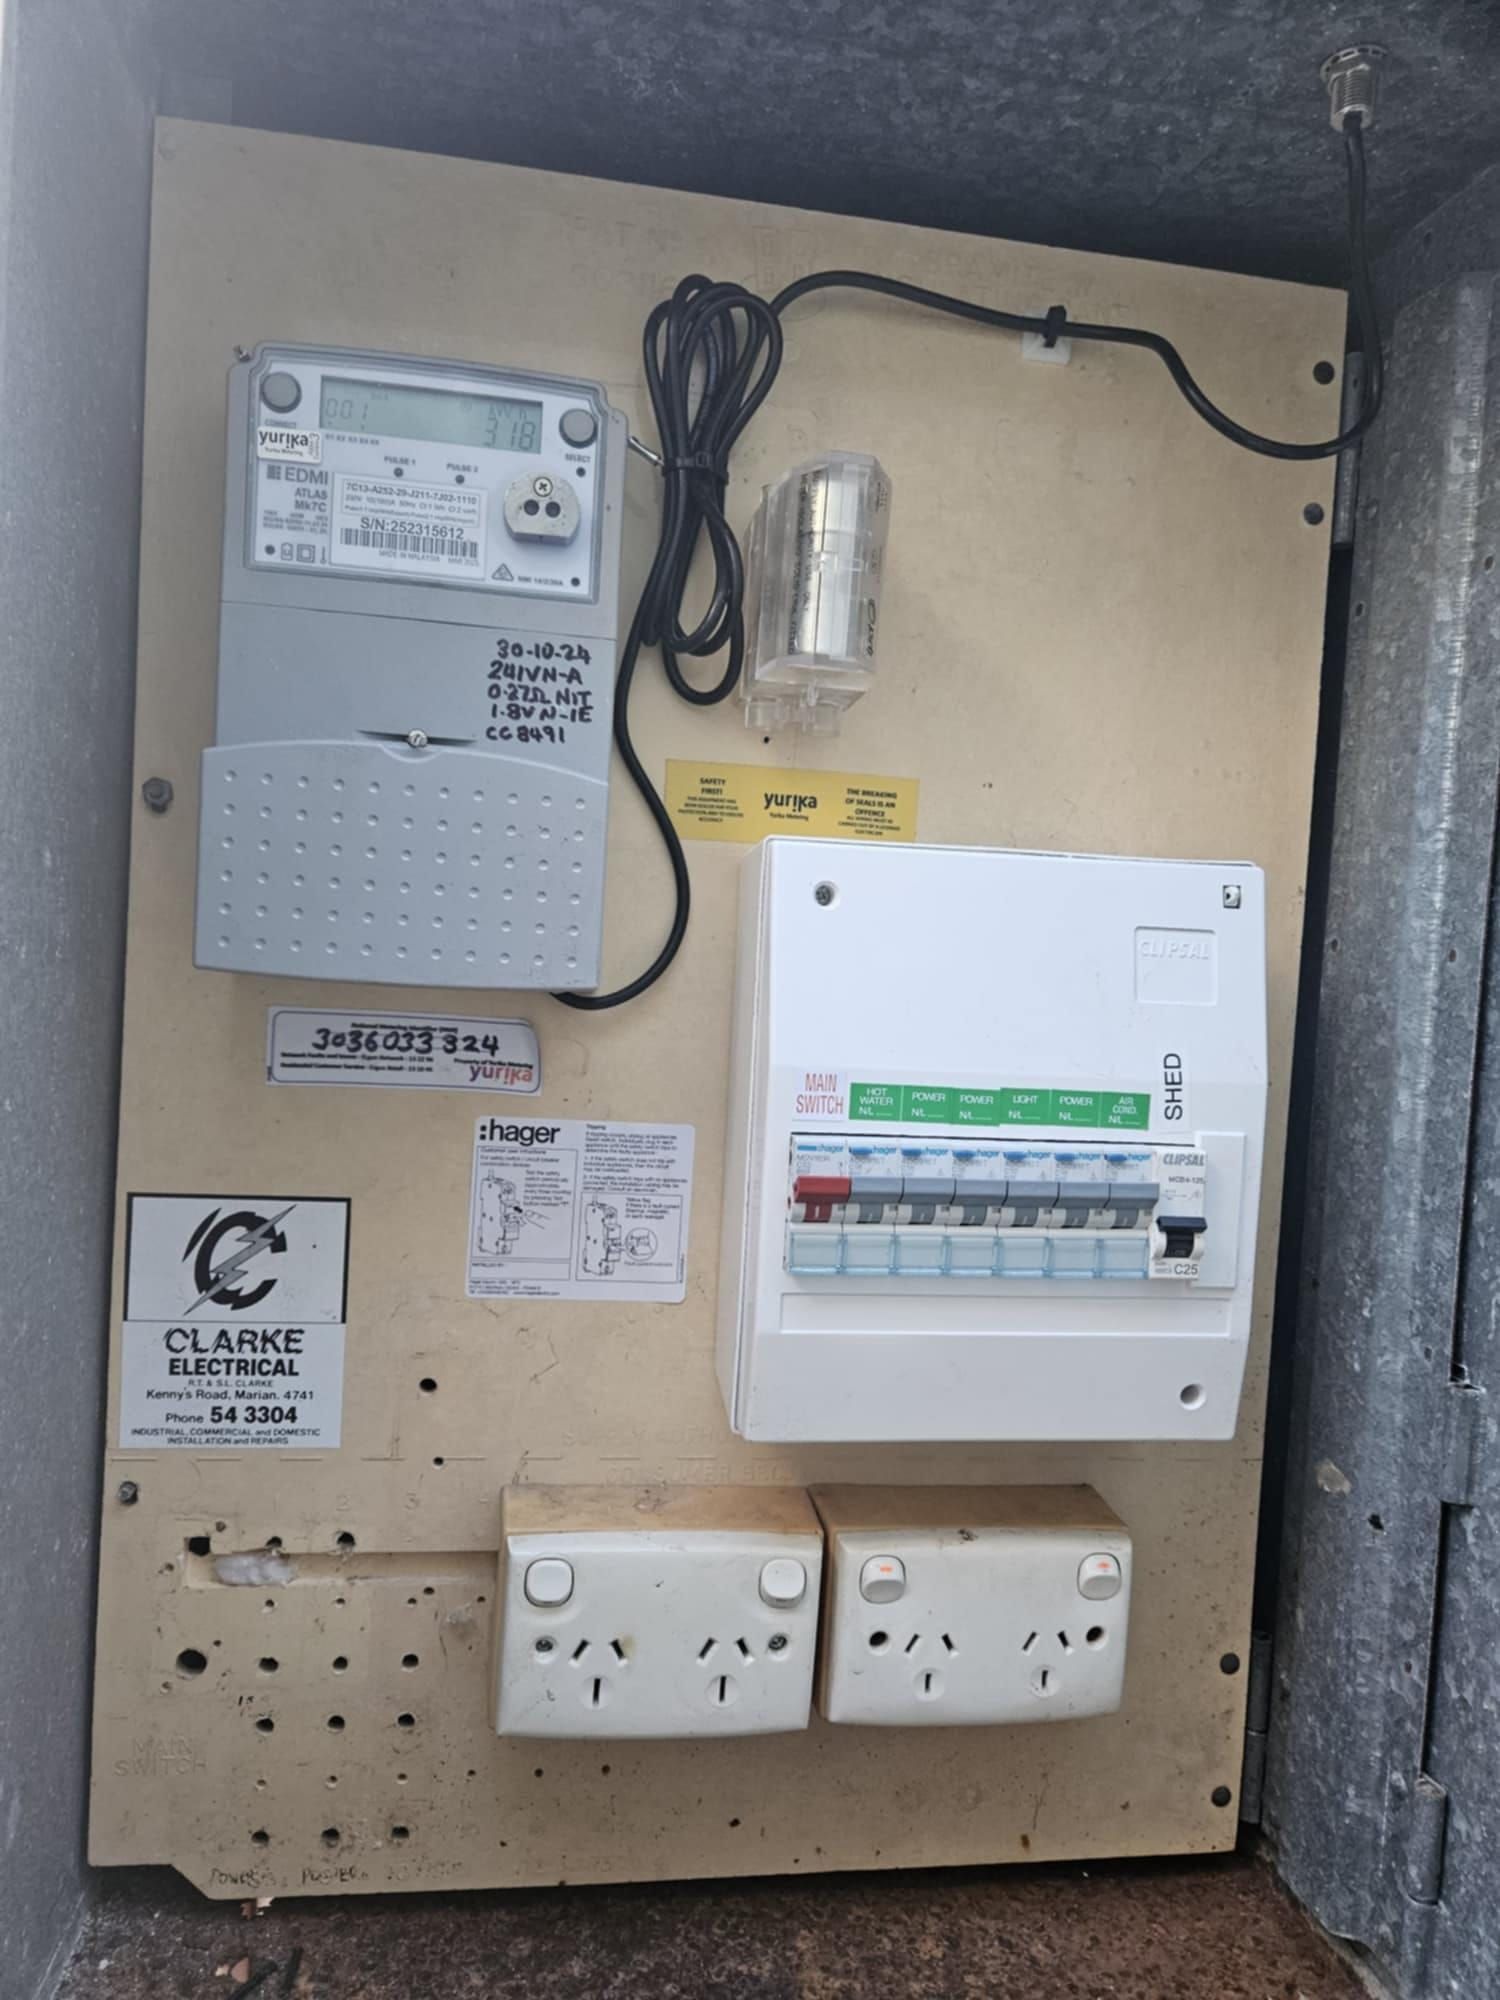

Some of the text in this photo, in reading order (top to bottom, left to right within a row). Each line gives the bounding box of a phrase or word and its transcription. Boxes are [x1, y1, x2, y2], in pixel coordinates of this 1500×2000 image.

[259, 430, 309, 449] yurika
[384, 455, 410, 465] PULSE
[446, 463, 472, 472] PULSE
[285, 466, 329, 486] EDMI
[295, 487, 328, 500] ATLAS
[360, 516, 466, 542] S/N:252315612
[496, 638, 592, 665] 30-10-24
[700, 777, 727, 786] SAFETY
[764, 792, 818, 813] yurika
[469, 1065, 533, 1085] yurika
[805, 1073, 837, 1092] MAIN
[1163, 1053, 1184, 1121] SHED
[866, 1087, 888, 1097] HOT
[912, 1091, 946, 1103] POWER
[796, 1094, 844, 1115] SWITCH
[859, 1096, 893, 1106] WATER
[960, 1094, 994, 1105] POWER
[1012, 1094, 1038, 1105] LIGHT
[1059, 1095, 1093, 1106] POWER
[1163, 1152, 1206, 1168] CLIPSAL
[1174, 1263, 1199, 1276] C25
[163, 1327, 305, 1355] CLARKE
[168, 1357, 300, 1377] ELECTRICAL
[206, 1380, 213, 1388] &
[235, 1380, 274, 1388] CLARKE
[146, 1387, 193, 1403] Kenny's
[282, 1390, 315, 1401] 4741
[165, 1405, 299, 1424] Phone 54 3304
[189, 1427, 253, 1438] COMMERCIAL
[255, 1429, 272, 1437] and
[273, 1428, 322, 1438] DOMESTIC
[167, 1436, 232, 1446] INSTALLATION
[250, 1437, 289, 1446] REPAIRS
